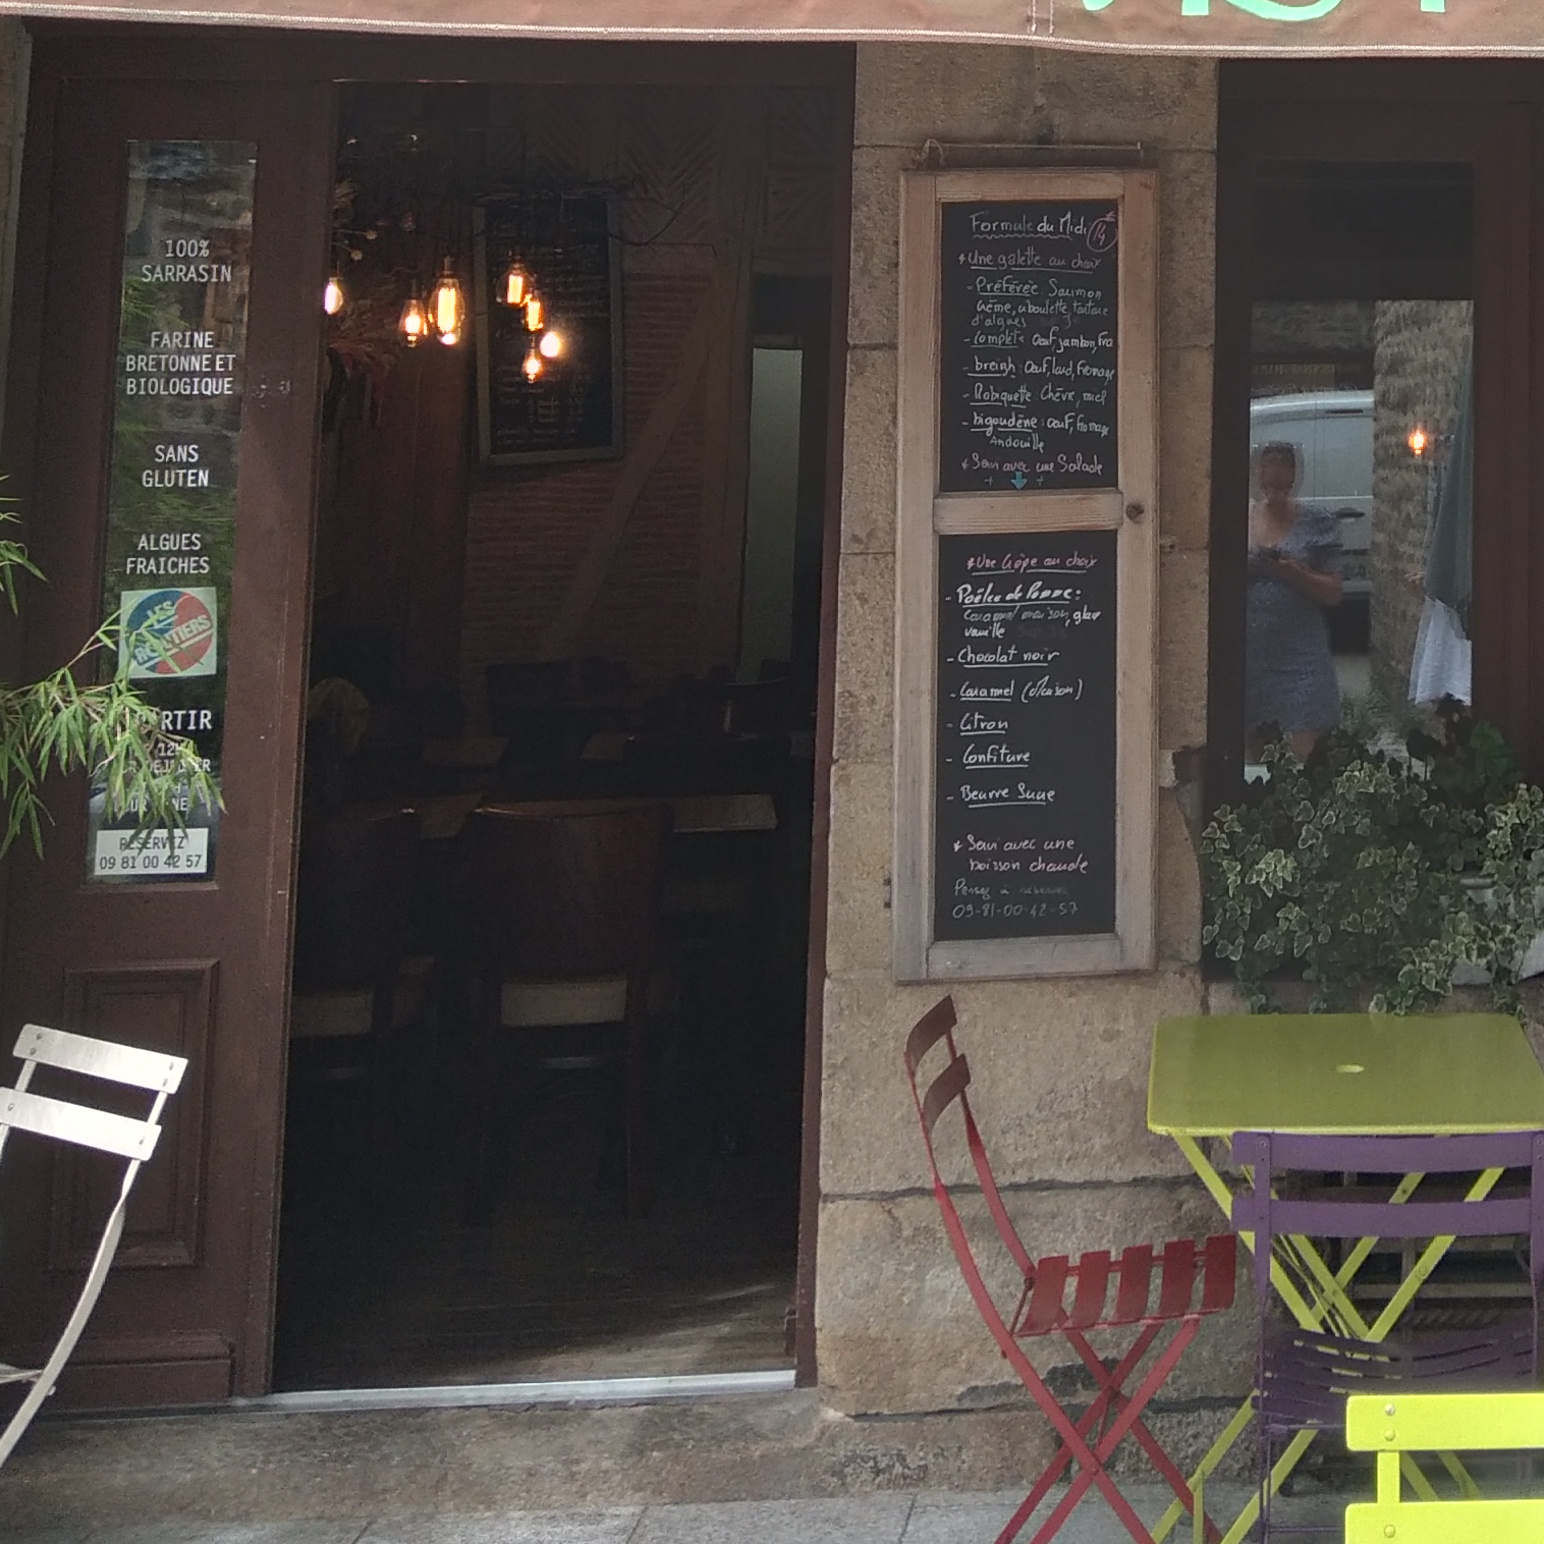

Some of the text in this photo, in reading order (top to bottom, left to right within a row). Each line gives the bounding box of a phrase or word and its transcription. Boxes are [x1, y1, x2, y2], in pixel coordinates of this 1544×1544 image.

[969, 210, 1087, 235] Formule du Midi
[165, 239, 210, 258] 100%
[968, 249, 994, 266] Une
[997, 245, 1042, 270] galette
[1049, 255, 1066, 266] au
[141, 264, 232, 283] SARRASIN
[151, 331, 215, 348] FARINE
[125, 354, 237, 372] BRETONNE ET
[126, 378, 234, 396] BIOLOGIQUE
[155, 444, 199, 463] SANS
[1002, 461, 1030, 472] avec
[1036, 462, 1055, 473] une
[141, 469, 209, 488] GLUTEN
[137, 532, 201, 551] ALGUES
[126, 556, 210, 575] FRAICHES
[976, 554, 996, 569] Une
[1043, 557, 1060, 566] au
[1065, 550, 1098, 569] choix
[1005, 583, 1023, 601] de
[964, 622, 1006, 639] vanille
[1023, 647, 1060, 661] noir
[960, 784, 1009, 802] Beurre
[119, 836, 186, 851] RSERVZ
[967, 833, 1077, 851] Servi avec une
[99, 854, 202, 870] 09 81 00 42 57
[969, 853, 1089, 874] boisson chaude
[954, 877, 991, 900] Pensez
